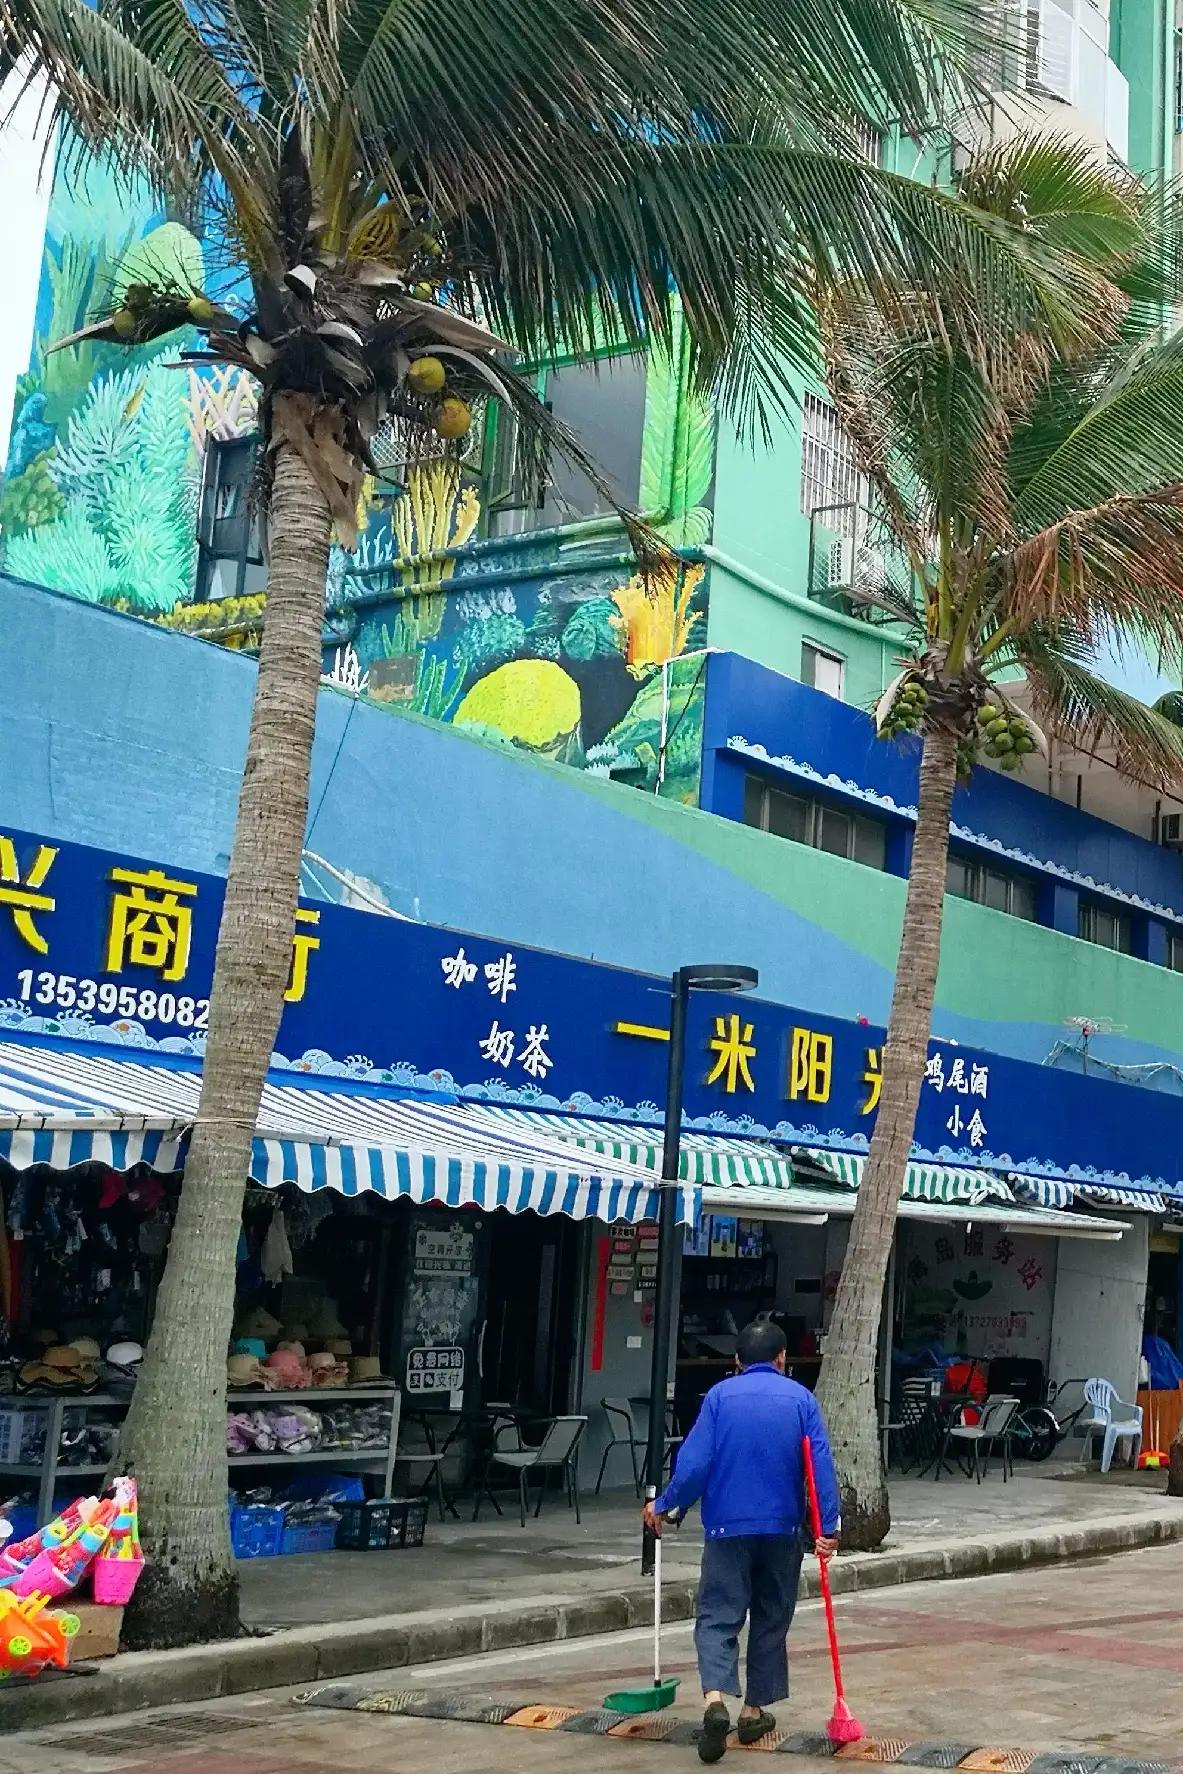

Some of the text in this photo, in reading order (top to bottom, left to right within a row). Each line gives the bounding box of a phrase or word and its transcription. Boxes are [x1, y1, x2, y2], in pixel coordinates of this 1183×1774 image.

[17, 968, 211, 1030] 1353958082
[441, 947, 518, 1004] 咖啡
[479, 1020, 554, 1079] 奶茶
[923, 1052, 989, 1099] 鸡尾酒
[946, 1104, 989, 1148] 小食
